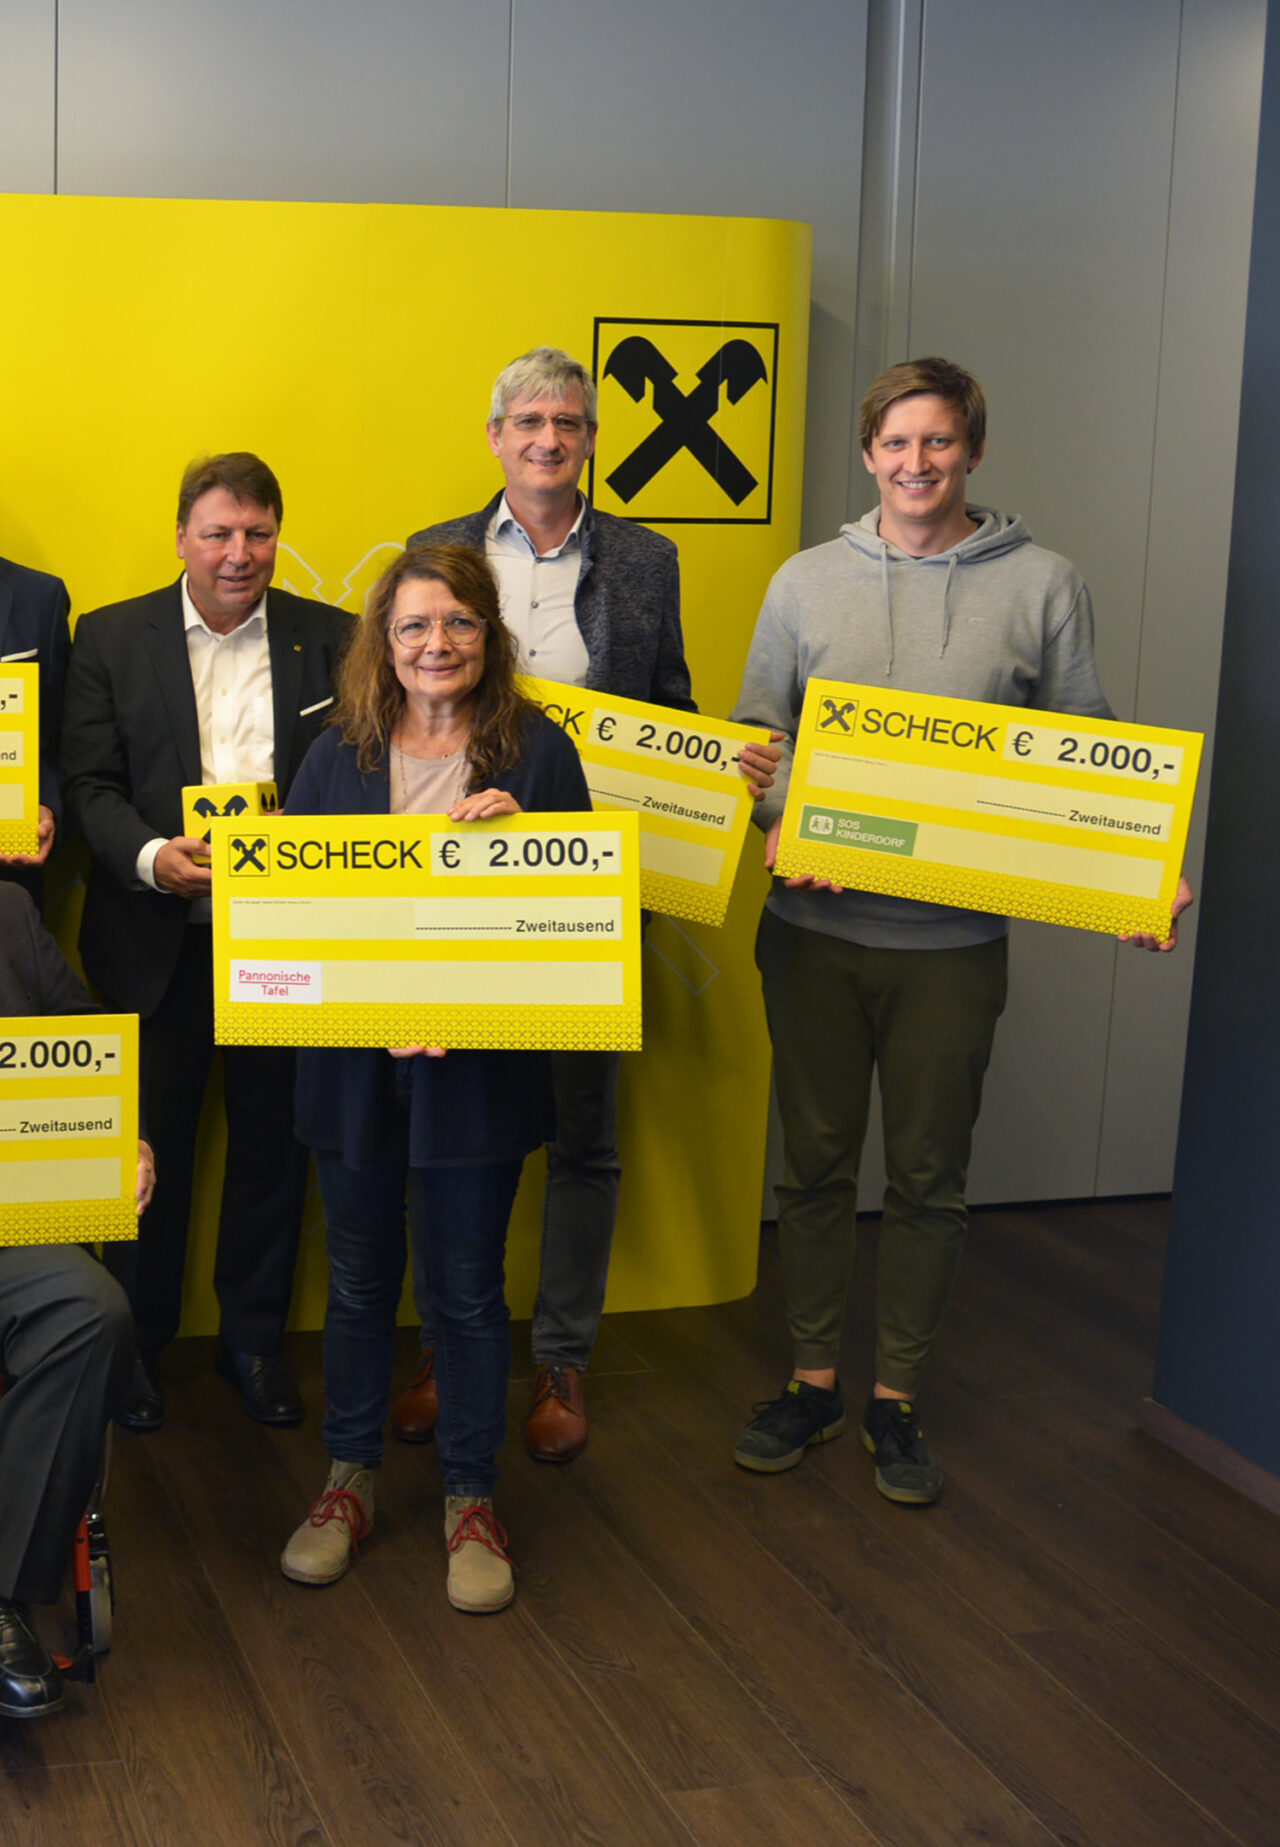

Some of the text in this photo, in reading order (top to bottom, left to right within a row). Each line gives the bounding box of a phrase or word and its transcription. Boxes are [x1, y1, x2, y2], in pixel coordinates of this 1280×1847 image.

[596, 717, 617, 742] €
[861, 706, 1176, 780] SCHECK € 2.000,-
[642, 796, 726, 826] Zweitausend
[838, 818, 860, 830] SOS
[1069, 809, 1162, 836] Zweitausend
[836, 828, 906, 847] KINDERDORF
[276, 837, 614, 871] SCHECK € 2.000,-
[515, 919, 615, 933] Zweitausend
[238, 969, 311, 982] Pannonische
[261, 985, 289, 996] Tafel
[19, 1118, 113, 1134] Zweitausend
